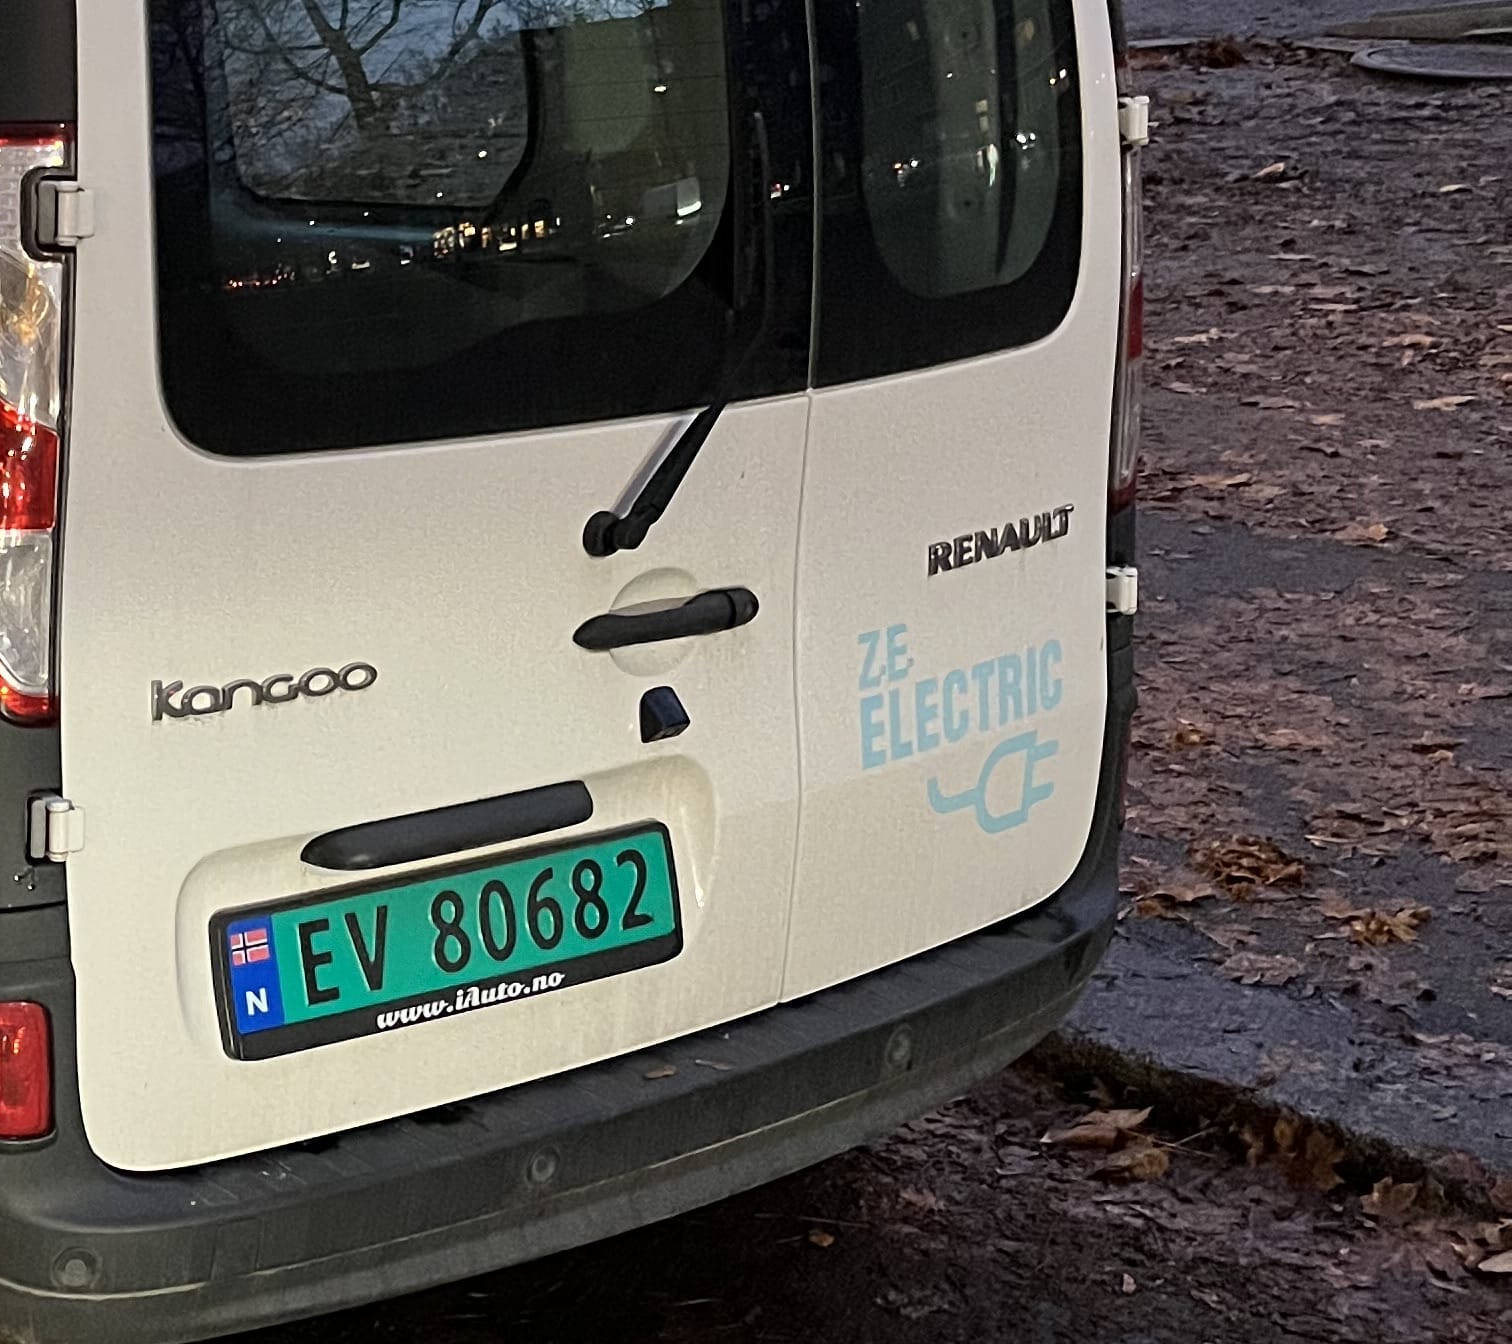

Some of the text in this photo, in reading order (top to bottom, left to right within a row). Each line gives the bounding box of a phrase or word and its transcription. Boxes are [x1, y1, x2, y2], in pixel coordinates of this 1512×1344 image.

[927, 503, 1075, 576] RENAULT
[150, 661, 378, 721] Kangoo
[859, 639, 1064, 771] ELECTRIC
[298, 849, 654, 1007] EV 80682
[245, 987, 270, 1017] N
[376, 971, 566, 1030] www.iAuto.no
